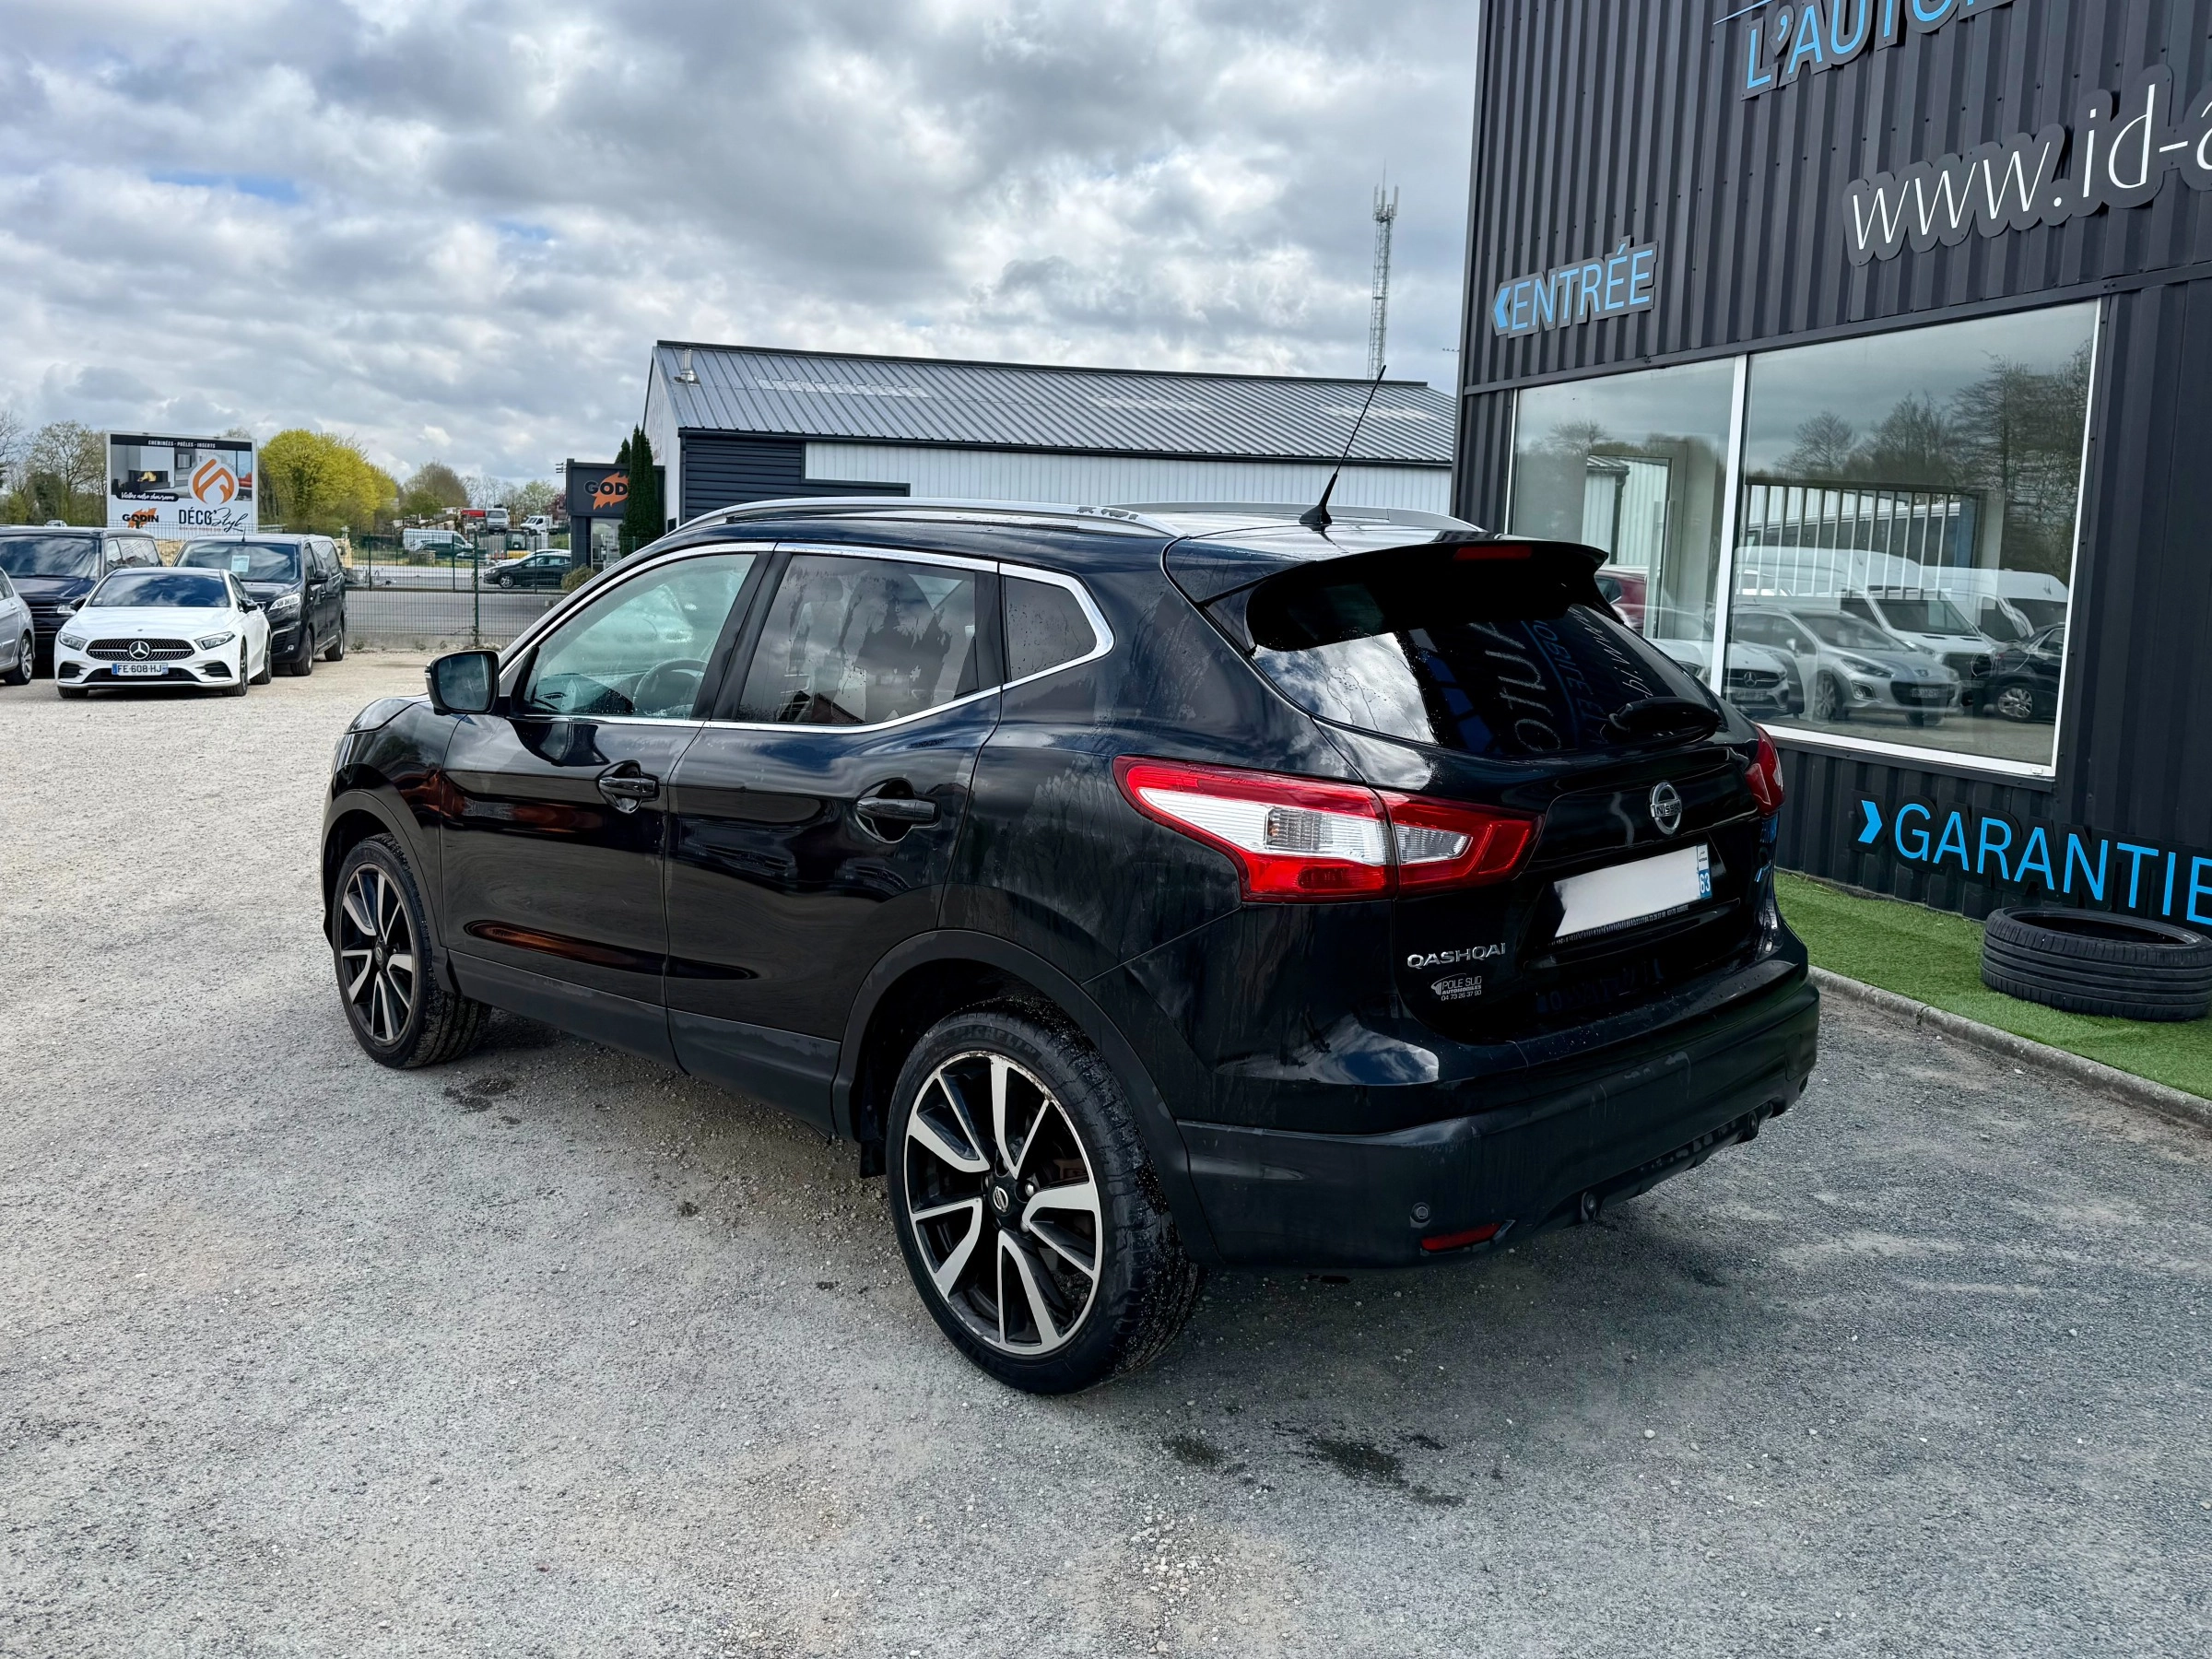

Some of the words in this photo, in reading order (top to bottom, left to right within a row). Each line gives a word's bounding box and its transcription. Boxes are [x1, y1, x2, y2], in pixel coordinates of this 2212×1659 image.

[1512, 242, 1653, 331] ENTRÉE
[584, 480, 629, 496] GOD
[122, 513, 159, 523] GODIN
[117, 665, 162, 673] FE-608-HJ
[1894, 803, 2212, 926] GARANTIE
[1699, 872, 1712, 894] 63
[1406, 942, 1506, 970] QASHQAI
[1441, 984, 1482, 995] AUTOMOBILES
[1442, 979, 1464, 991] POLE
[1465, 976, 1482, 987] SUD
